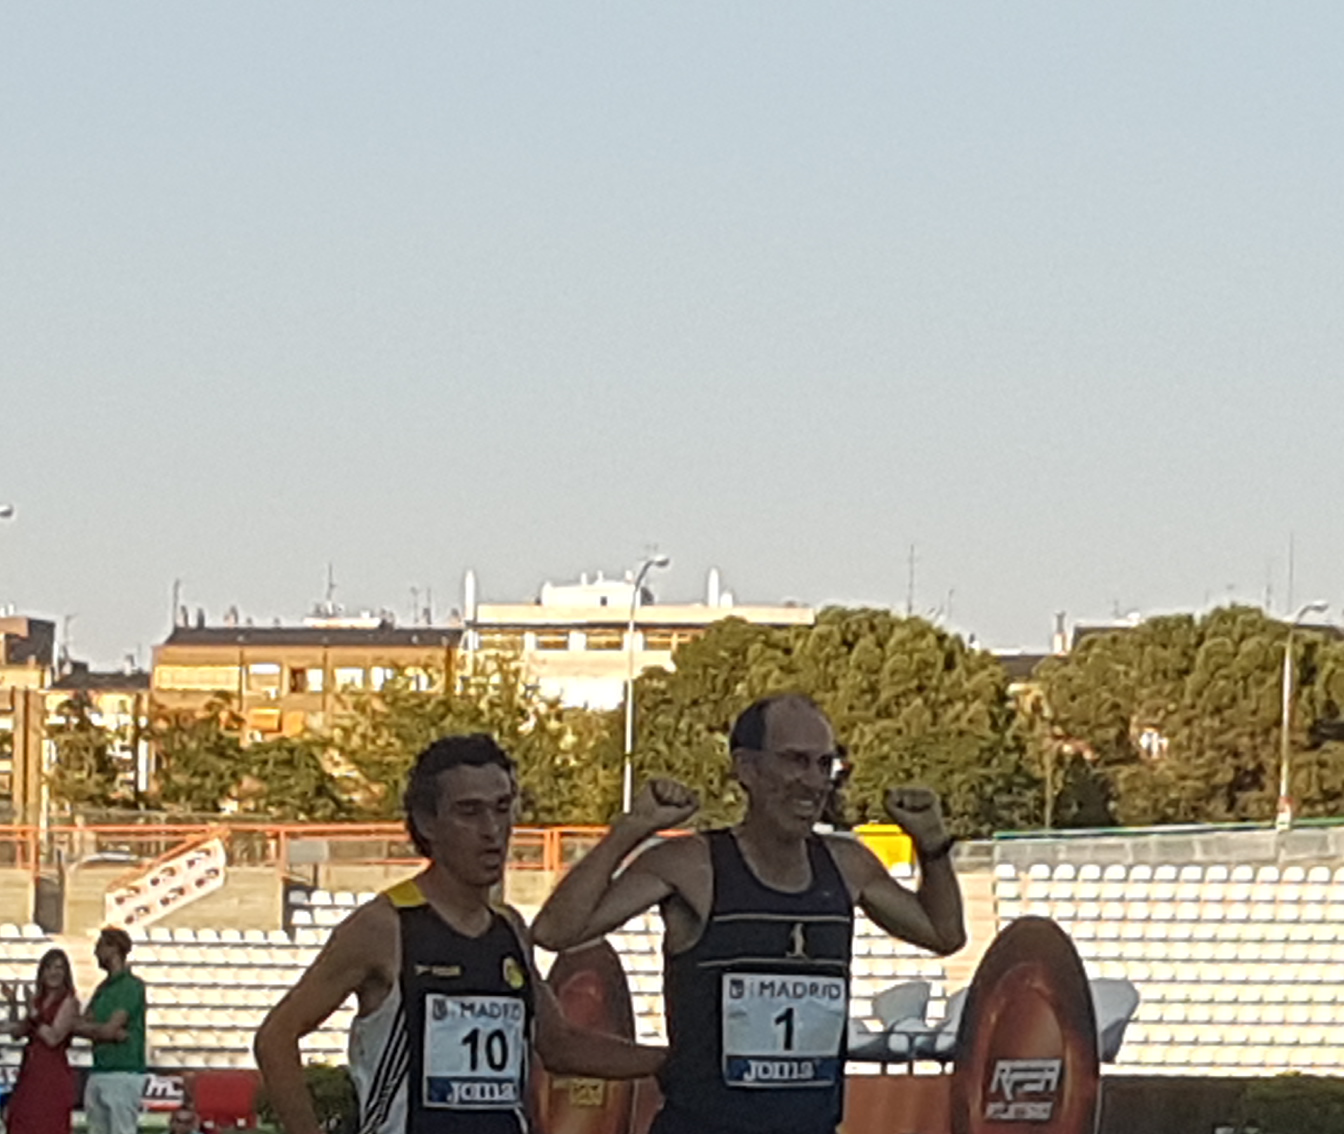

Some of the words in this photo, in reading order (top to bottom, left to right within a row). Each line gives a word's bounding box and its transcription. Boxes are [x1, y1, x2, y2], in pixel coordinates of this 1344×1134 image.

[759, 980, 841, 999] MADRID
[462, 1028, 509, 1072] 10
[775, 1007, 794, 1051] 1
